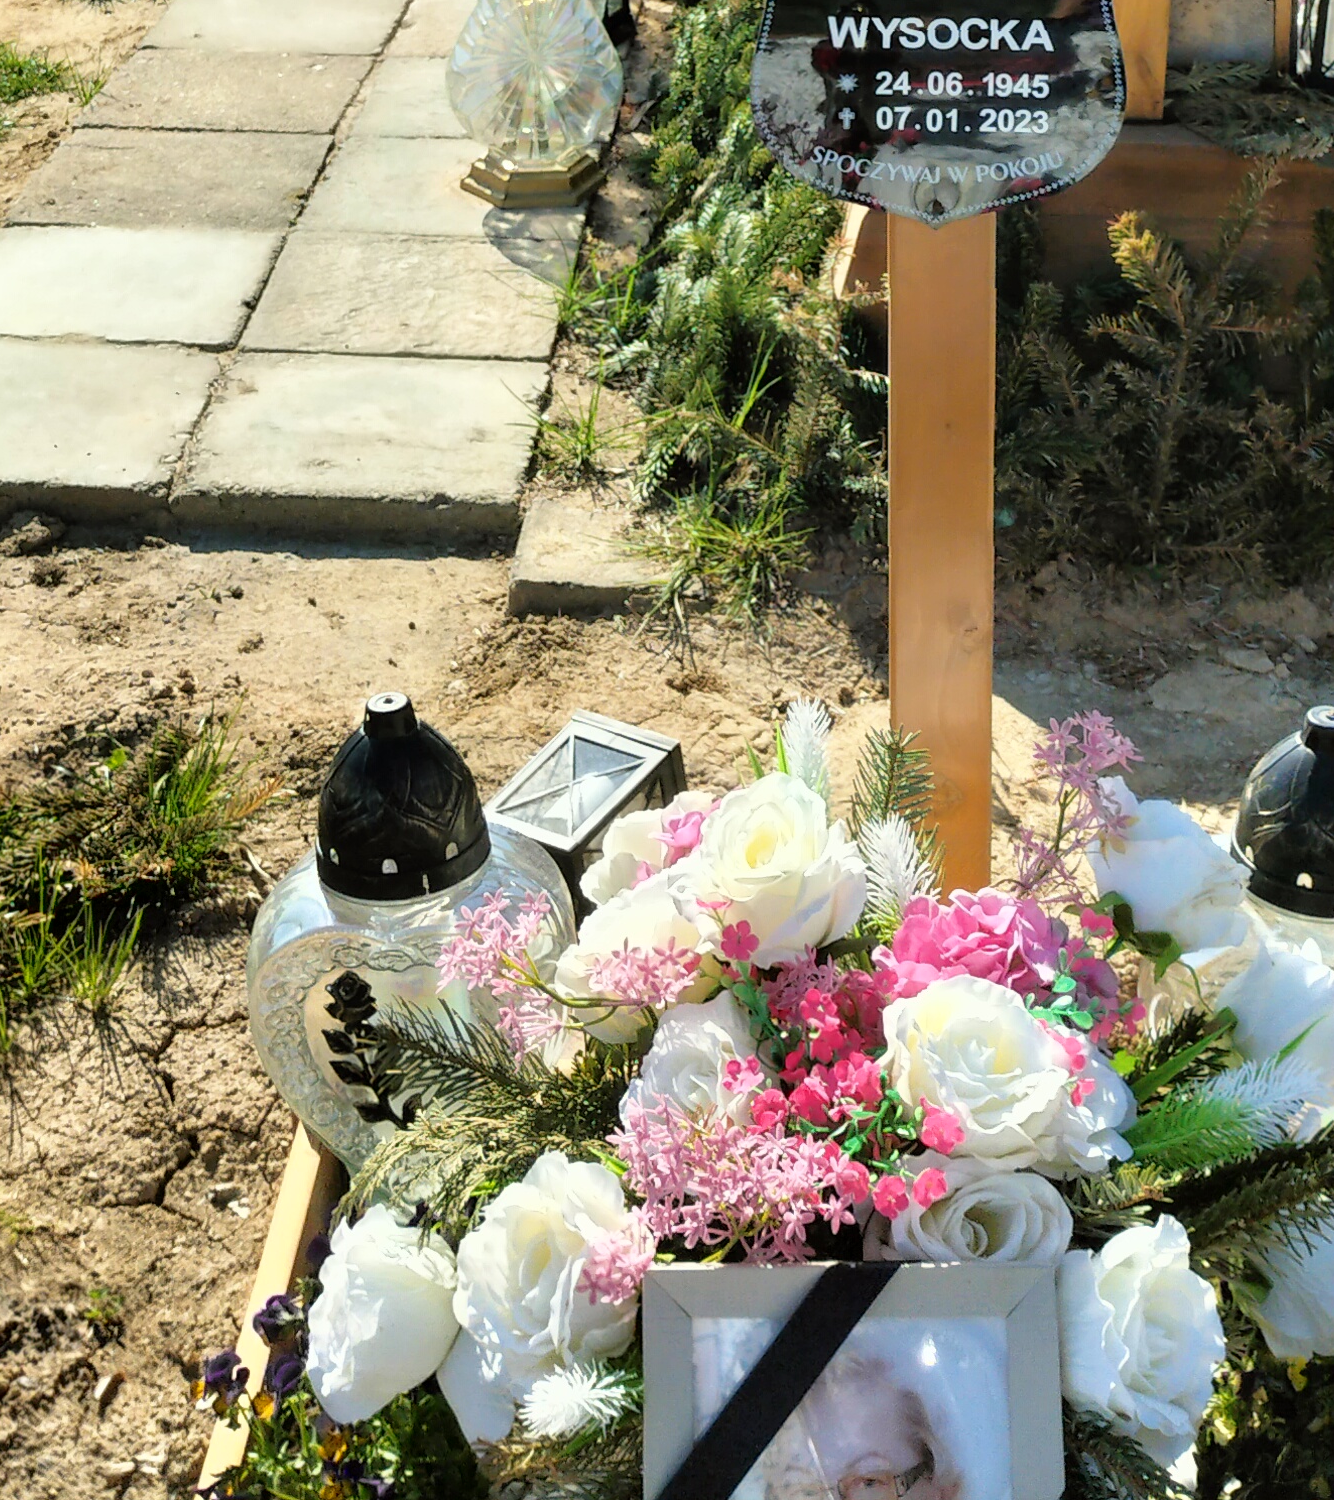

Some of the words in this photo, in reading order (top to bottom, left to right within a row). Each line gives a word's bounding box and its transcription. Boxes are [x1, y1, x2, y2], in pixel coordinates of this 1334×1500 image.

[827, 16, 1054, 52] WYSOCKA
[810, 145, 941, 185] SPOCZYWAJ
[946, 166, 970, 184] W
[975, 150, 1064, 183] POKOJU
